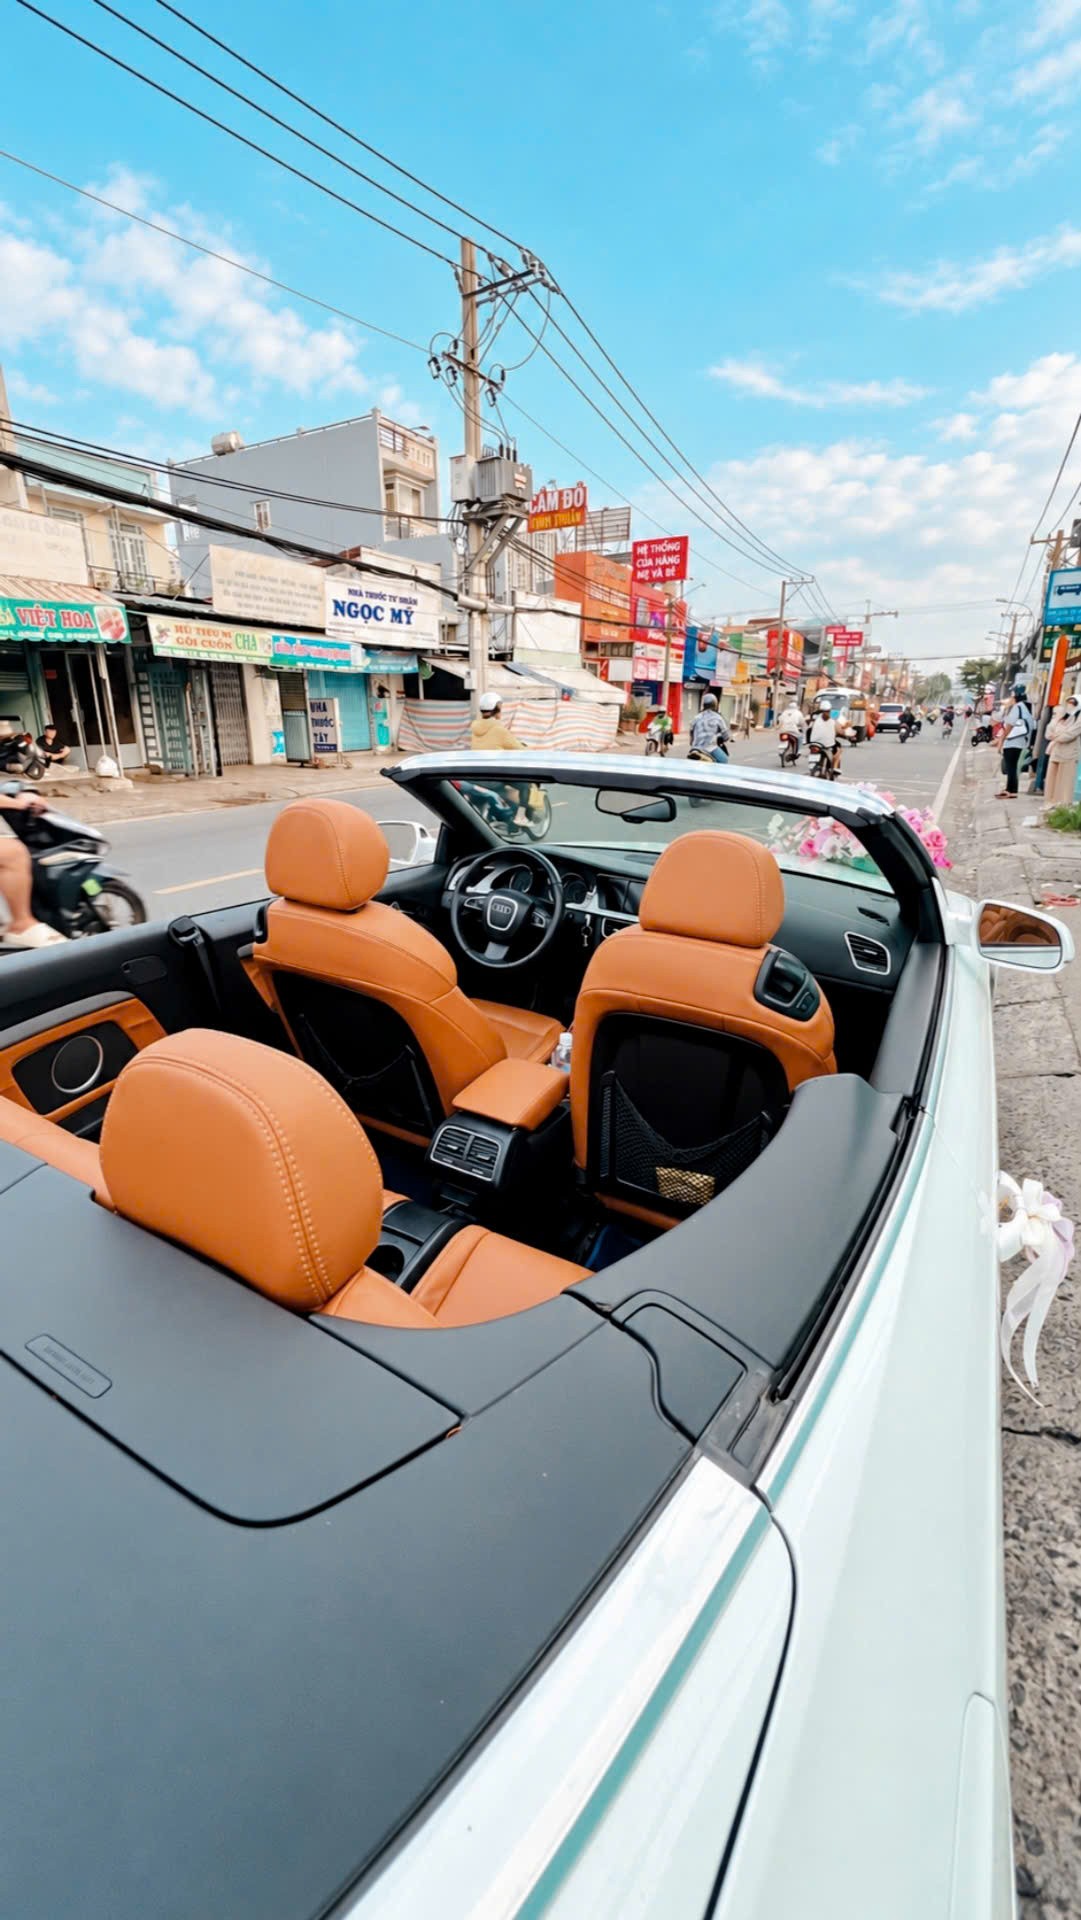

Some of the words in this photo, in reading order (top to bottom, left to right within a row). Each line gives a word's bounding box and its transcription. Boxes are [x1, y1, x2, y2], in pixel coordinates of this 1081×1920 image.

[651, 540, 680, 553] THỐNG
[655, 554, 680, 566] HÀNG
[651, 568, 663, 578] VÀ
[332, 599, 384, 624] NGỌC
[16, 604, 57, 633] VIỆT
[60, 610, 95, 629] HOA
